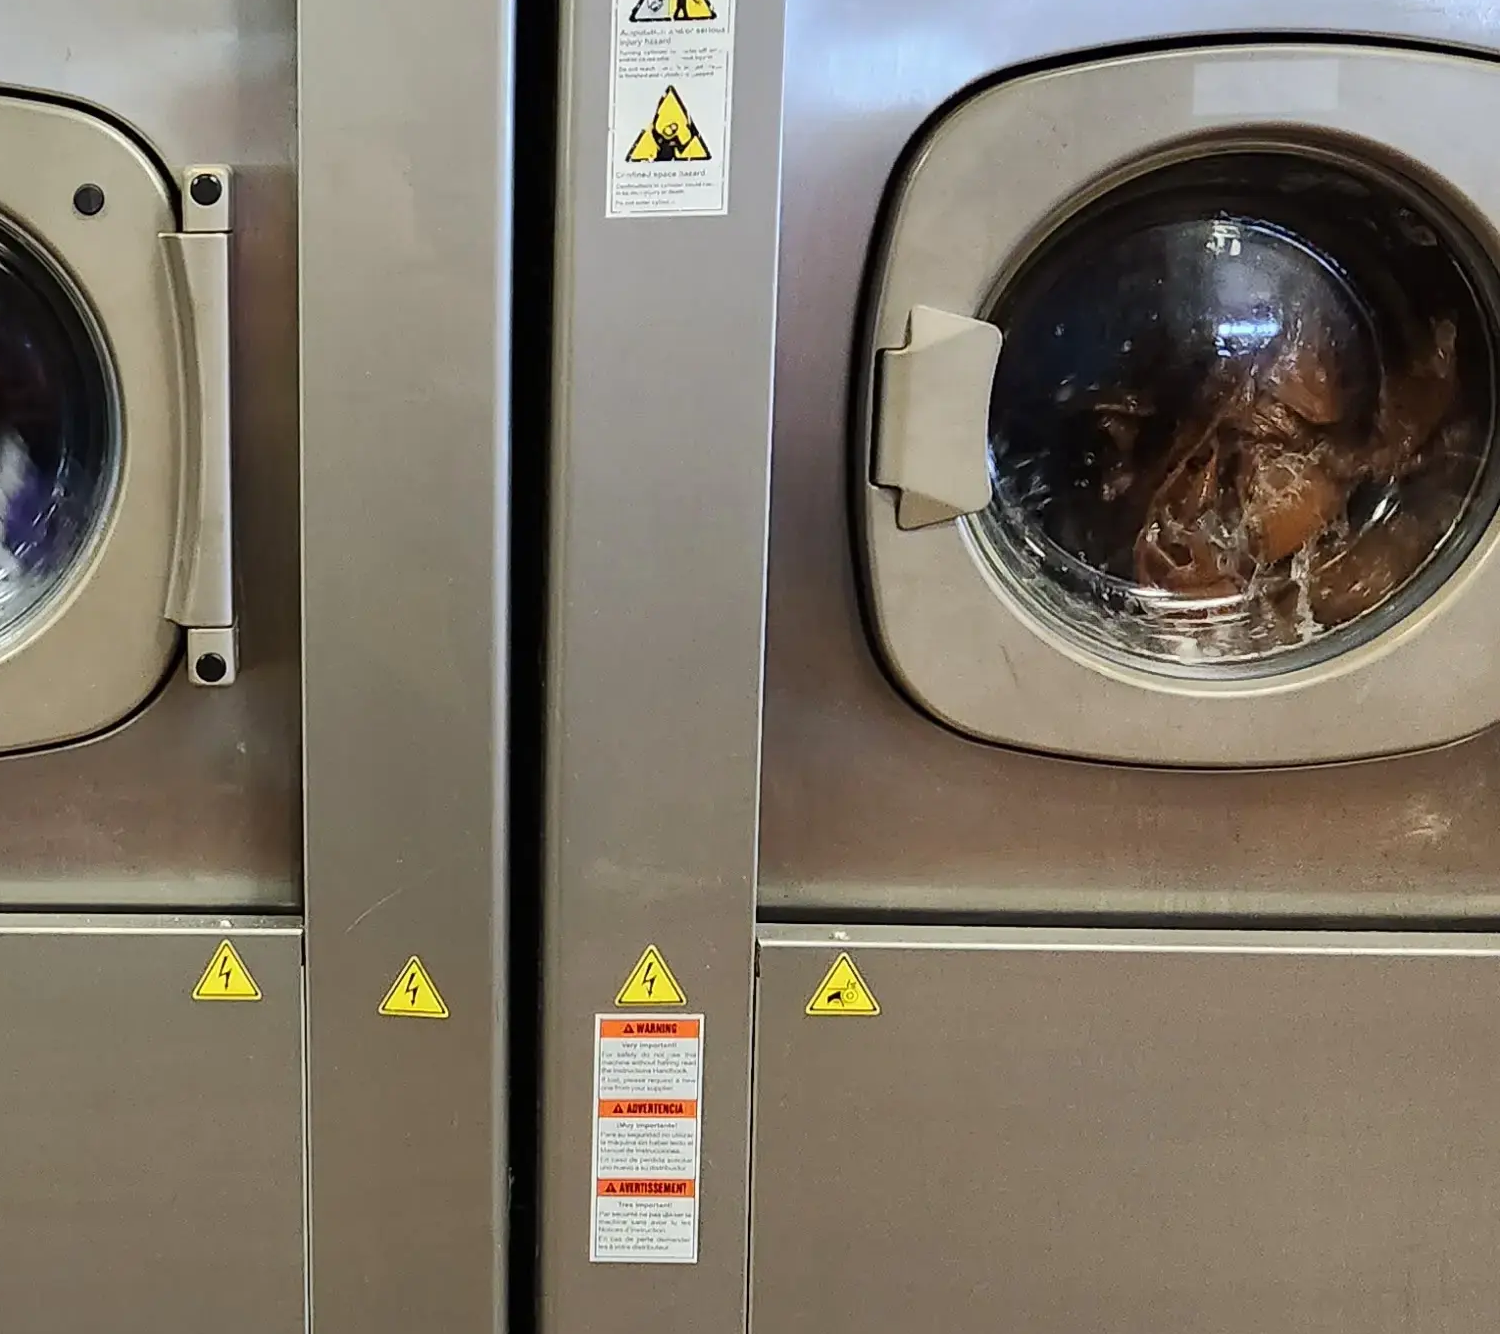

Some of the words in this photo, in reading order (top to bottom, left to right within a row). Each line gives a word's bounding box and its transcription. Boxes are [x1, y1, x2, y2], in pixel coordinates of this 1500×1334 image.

[636, 1023, 677, 1034] WARNING
[627, 1103, 684, 1114] ADVERTENCIA
[620, 1182, 687, 1194] AVERTISSEMENT
